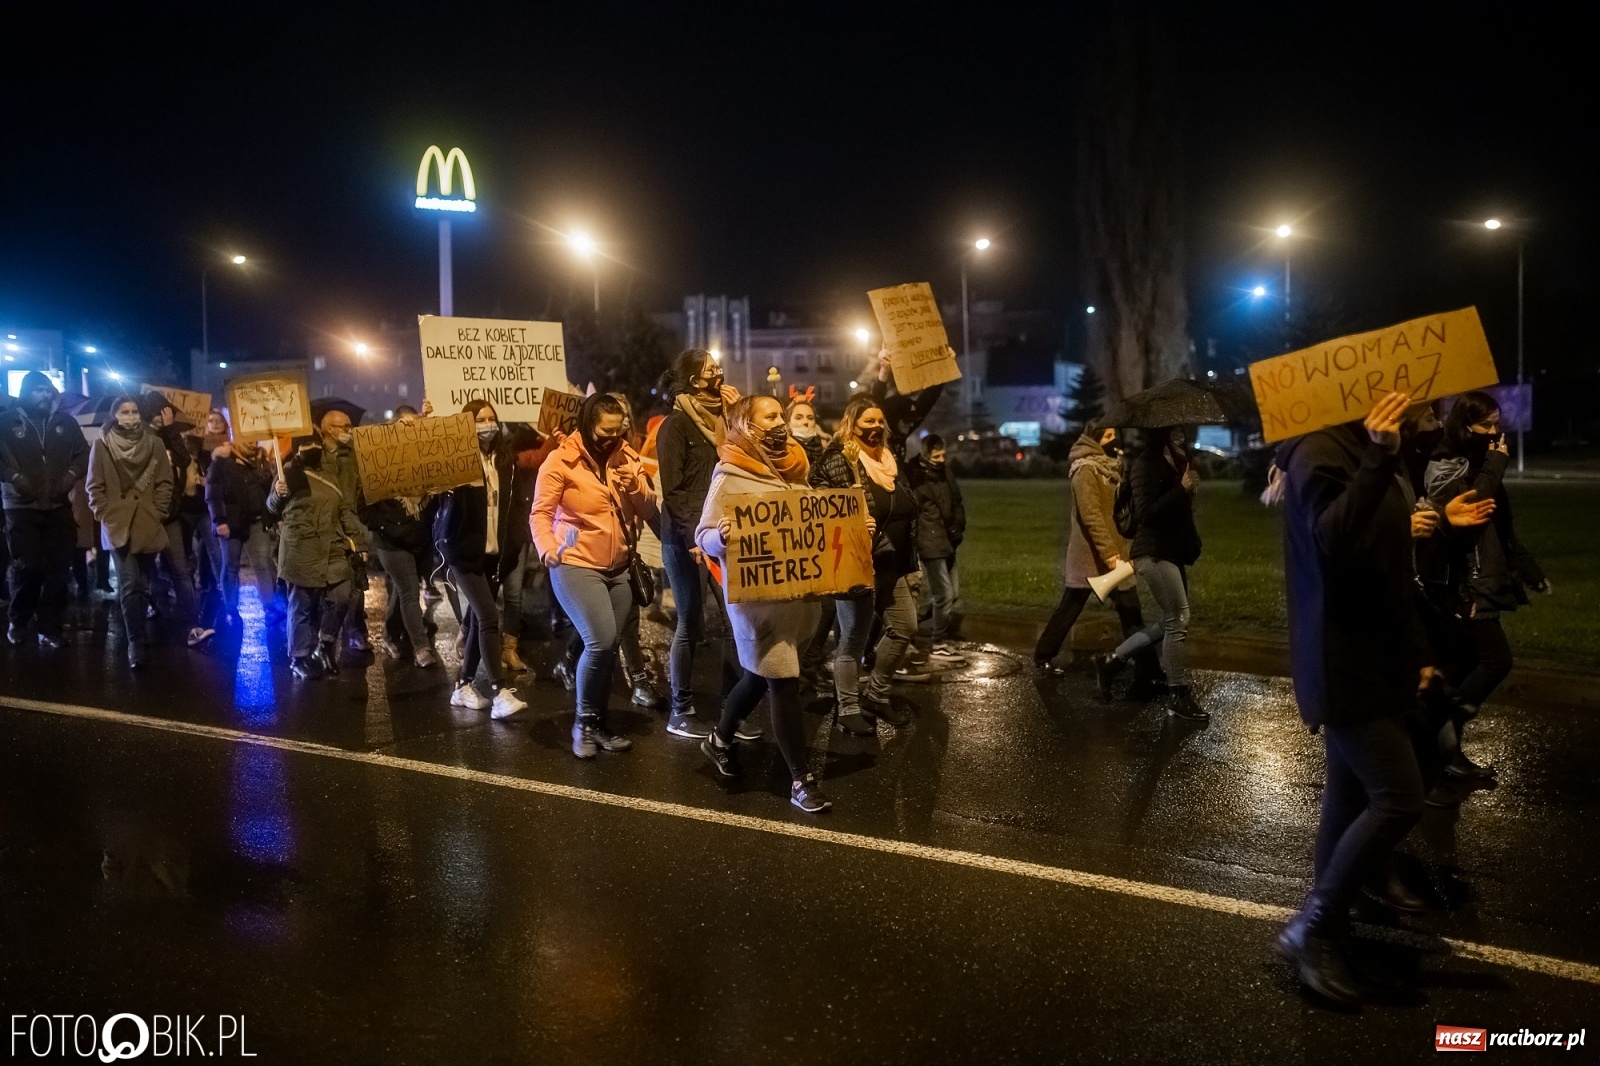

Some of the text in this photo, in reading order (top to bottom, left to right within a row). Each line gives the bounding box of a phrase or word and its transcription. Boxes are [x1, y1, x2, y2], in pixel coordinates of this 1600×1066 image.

[458, 328, 527, 343] BEZ KOBIET
[1302, 321, 1446, 383] WOMAN
[426, 345, 563, 366] DALEKO NIE ZAJDZIECIE
[462, 366, 535, 381] BEZ KOBIET
[1269, 353, 1442, 433] NO KRAJ
[356, 423, 398, 448] MOIM
[735, 494, 860, 530] MOJA BROSZKA
[739, 521, 826, 557] NIE TWÓJ
[740, 555, 823, 588] INTERES
